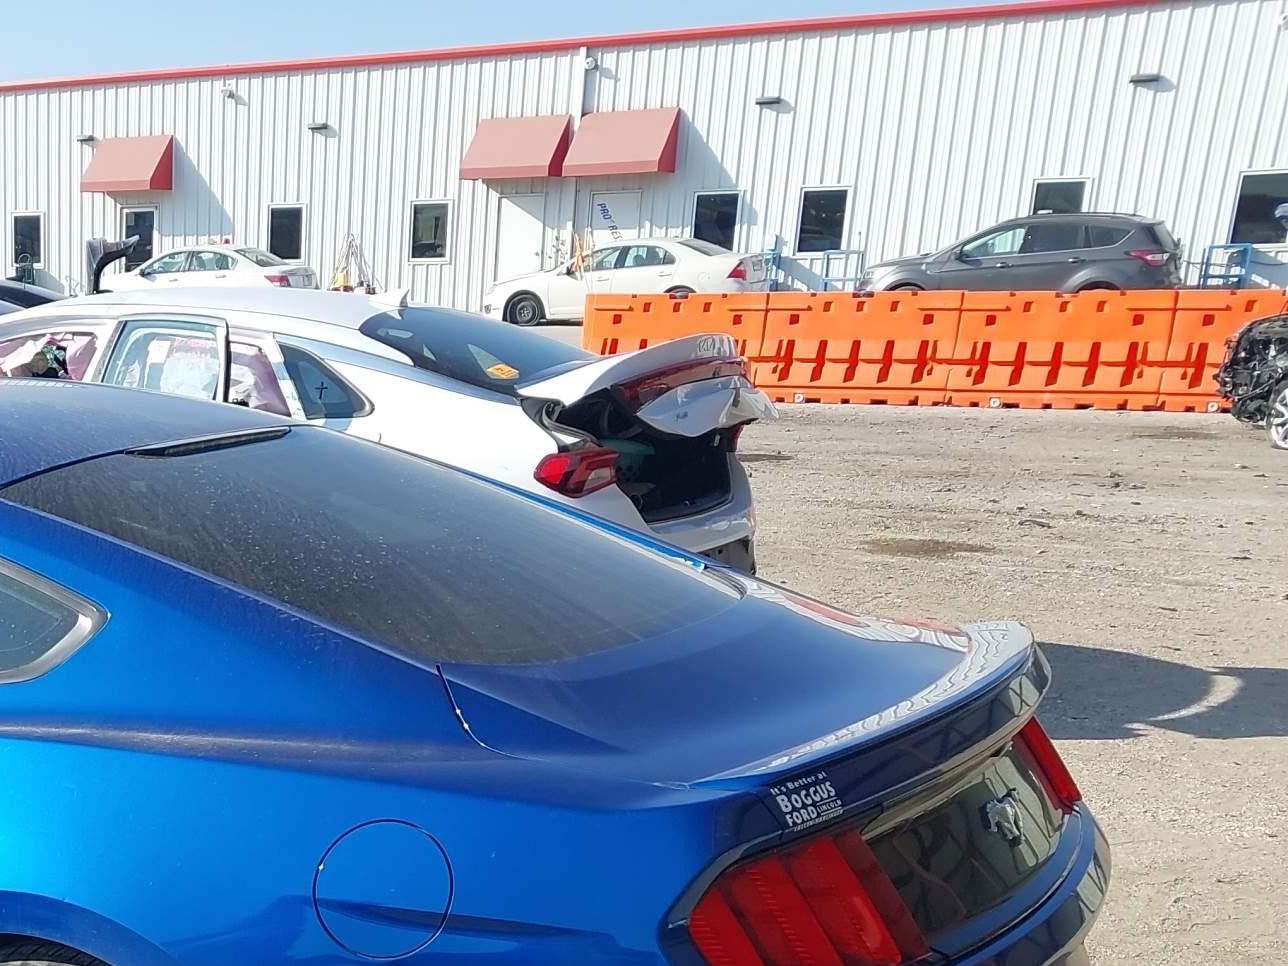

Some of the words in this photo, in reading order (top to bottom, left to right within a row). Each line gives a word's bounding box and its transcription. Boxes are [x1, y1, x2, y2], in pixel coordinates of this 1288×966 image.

[770, 785, 786, 796] It's
[786, 775, 816, 789] Better
[816, 771, 828, 779] at
[775, 781, 836, 813] BOGGUS
[785, 806, 818, 826] FORD
[816, 799, 842, 813] LINCOLN
